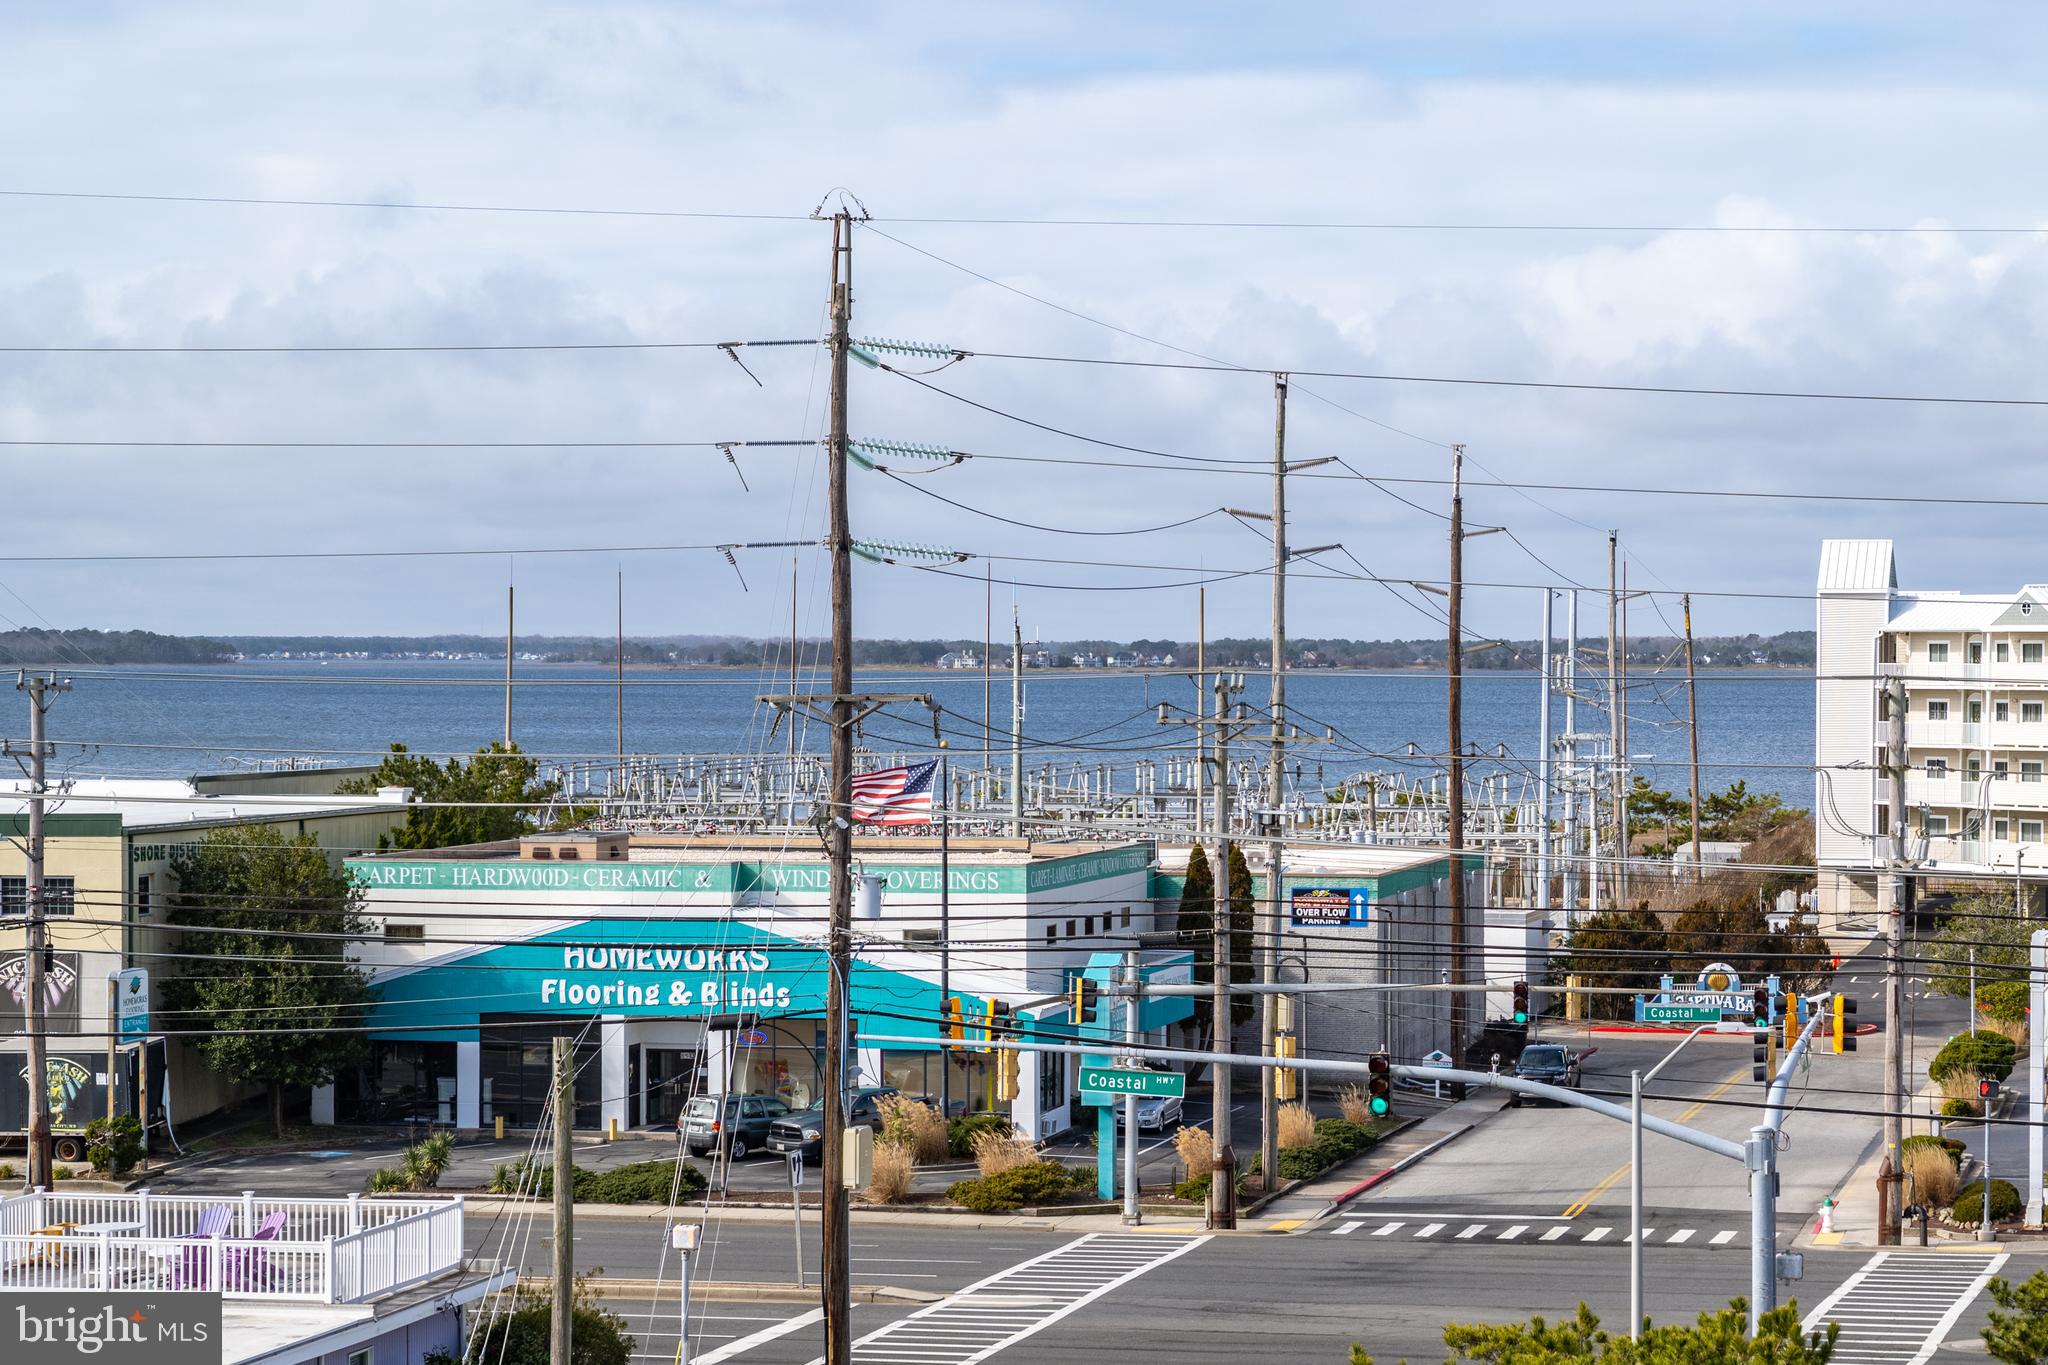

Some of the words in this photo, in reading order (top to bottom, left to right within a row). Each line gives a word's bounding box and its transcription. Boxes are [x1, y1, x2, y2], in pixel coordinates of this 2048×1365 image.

[133, 845, 165, 862] SHORE
[169, 841, 201, 859] DISTRI
[353, 866, 437, 885] CARPET
[583, 869, 682, 888] CERAMIC
[694, 870, 712, 888] &
[772, 869, 831, 888] WIND
[1296, 908, 1320, 916] OVER
[1321, 908, 1347, 917] FLOW
[563, 942, 770, 971] HOMEWORKS
[541, 979, 660, 1006] Flooring
[668, 980, 693, 1006] &
[1735, 995, 1755, 1012] BA
[1650, 1008, 1693, 1019] Coastal
[1088, 1073, 1147, 1090] Coastal
[1156, 1076, 1175, 1085] HWY
